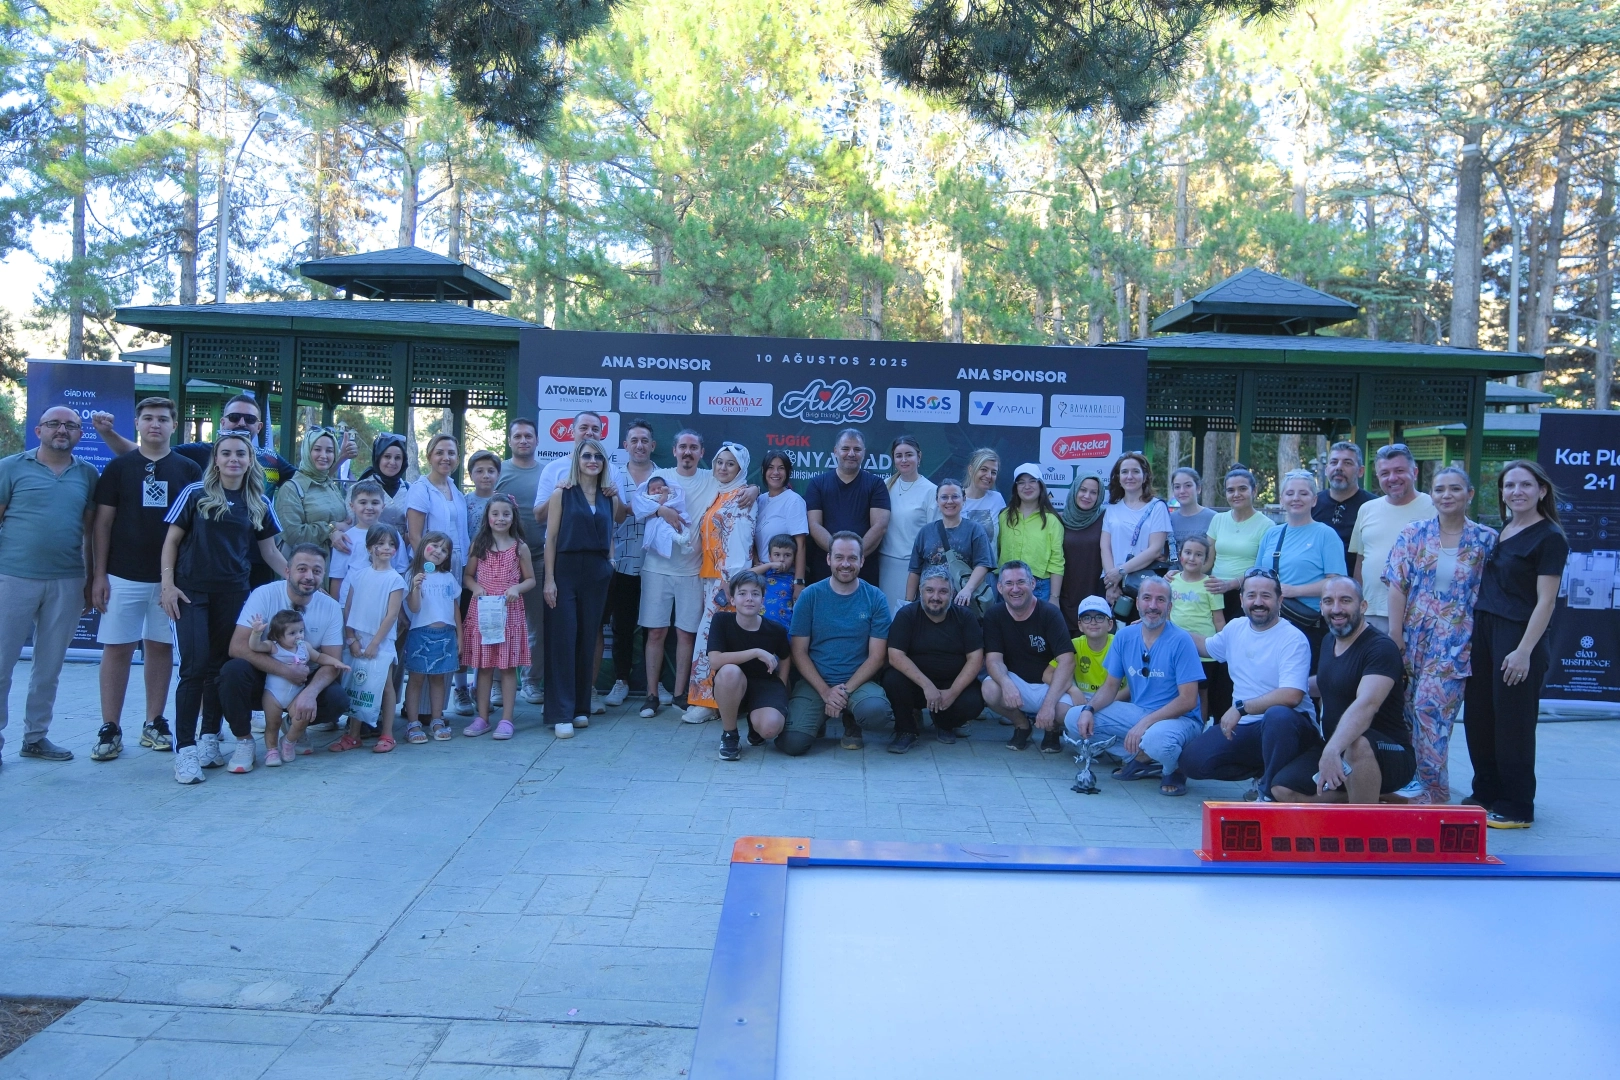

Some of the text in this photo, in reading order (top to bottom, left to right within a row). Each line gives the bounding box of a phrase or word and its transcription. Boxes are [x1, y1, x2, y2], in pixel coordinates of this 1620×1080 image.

[601, 355, 711, 371] ANA SPONSOR
[757, 352, 908, 367] 10 AĞUSTOS 2025
[956, 368, 1067, 383] ANA SPONSOR
[545, 385, 608, 397] ATOMEDYA
[639, 390, 687, 404] Erkoyuncu
[708, 396, 763, 407] KORKMAZ
[997, 405, 1034, 415] YAPALI
[1069, 439, 1109, 453] Akşeker
[1555, 448, 1591, 466] Kat
[1583, 473, 1616, 491] 2+1
[1136, 667, 1165, 678] Cmbia
